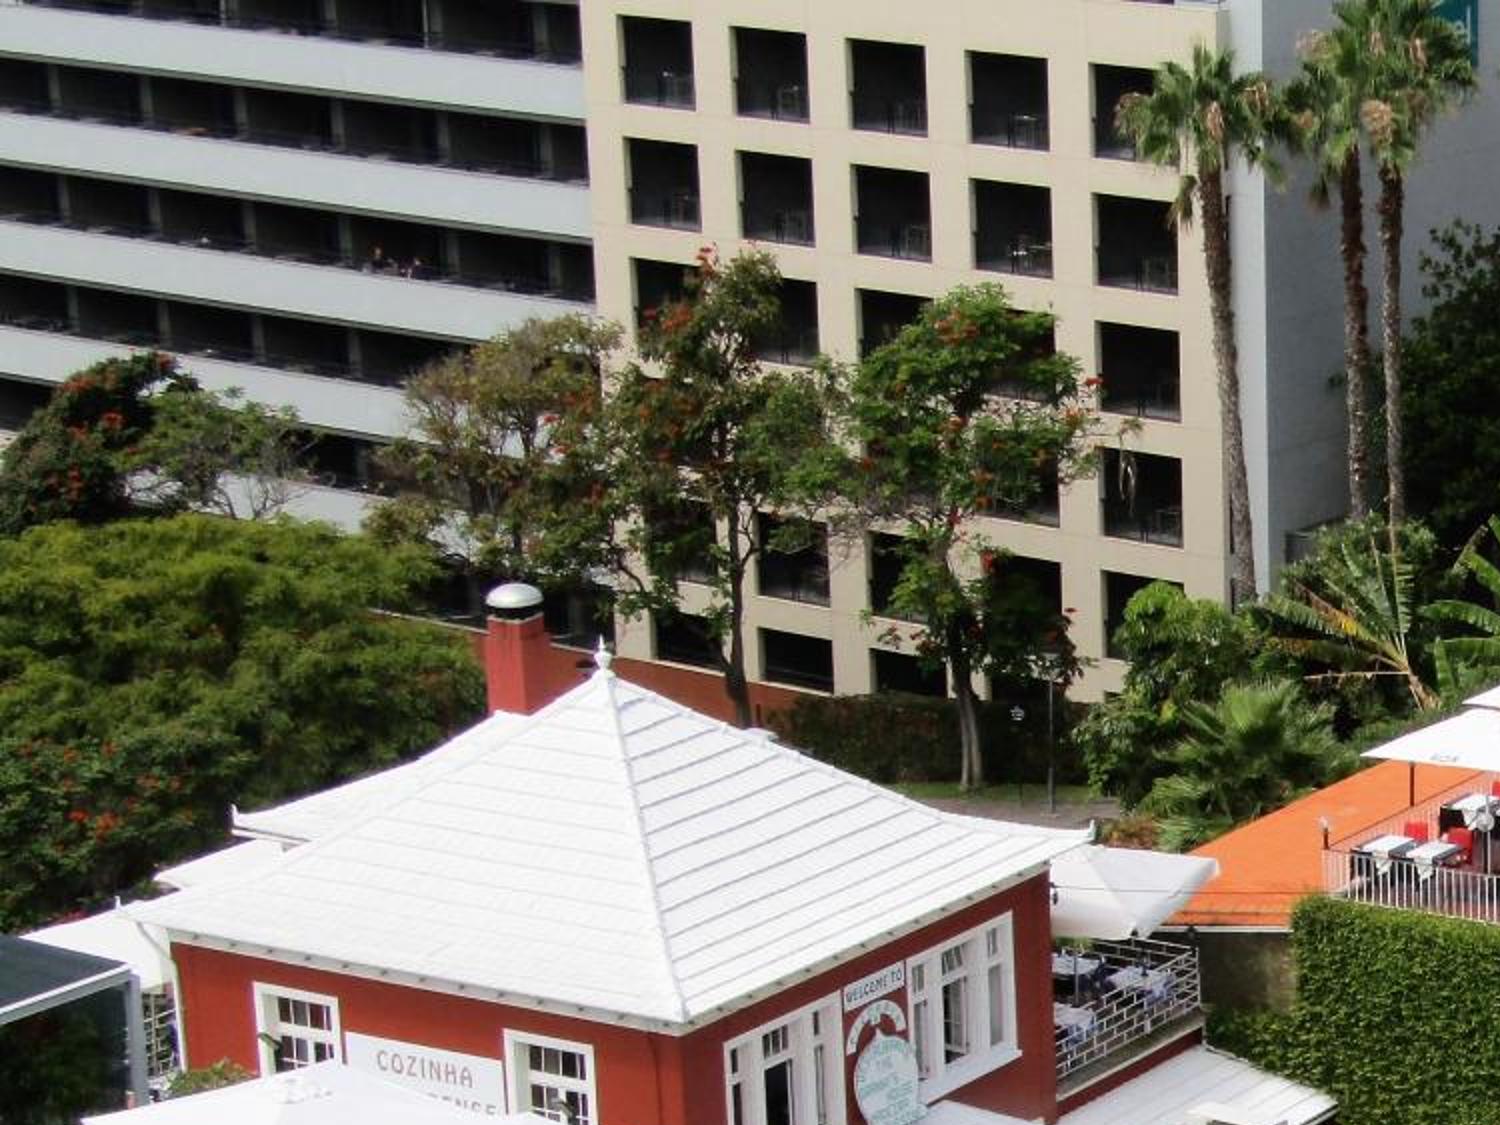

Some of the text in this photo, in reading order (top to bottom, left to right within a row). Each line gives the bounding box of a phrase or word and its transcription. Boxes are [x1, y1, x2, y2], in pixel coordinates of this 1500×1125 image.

[846, 968, 903, 1003] WELCOME TO
[376, 1049, 474, 1089] COZINHA
